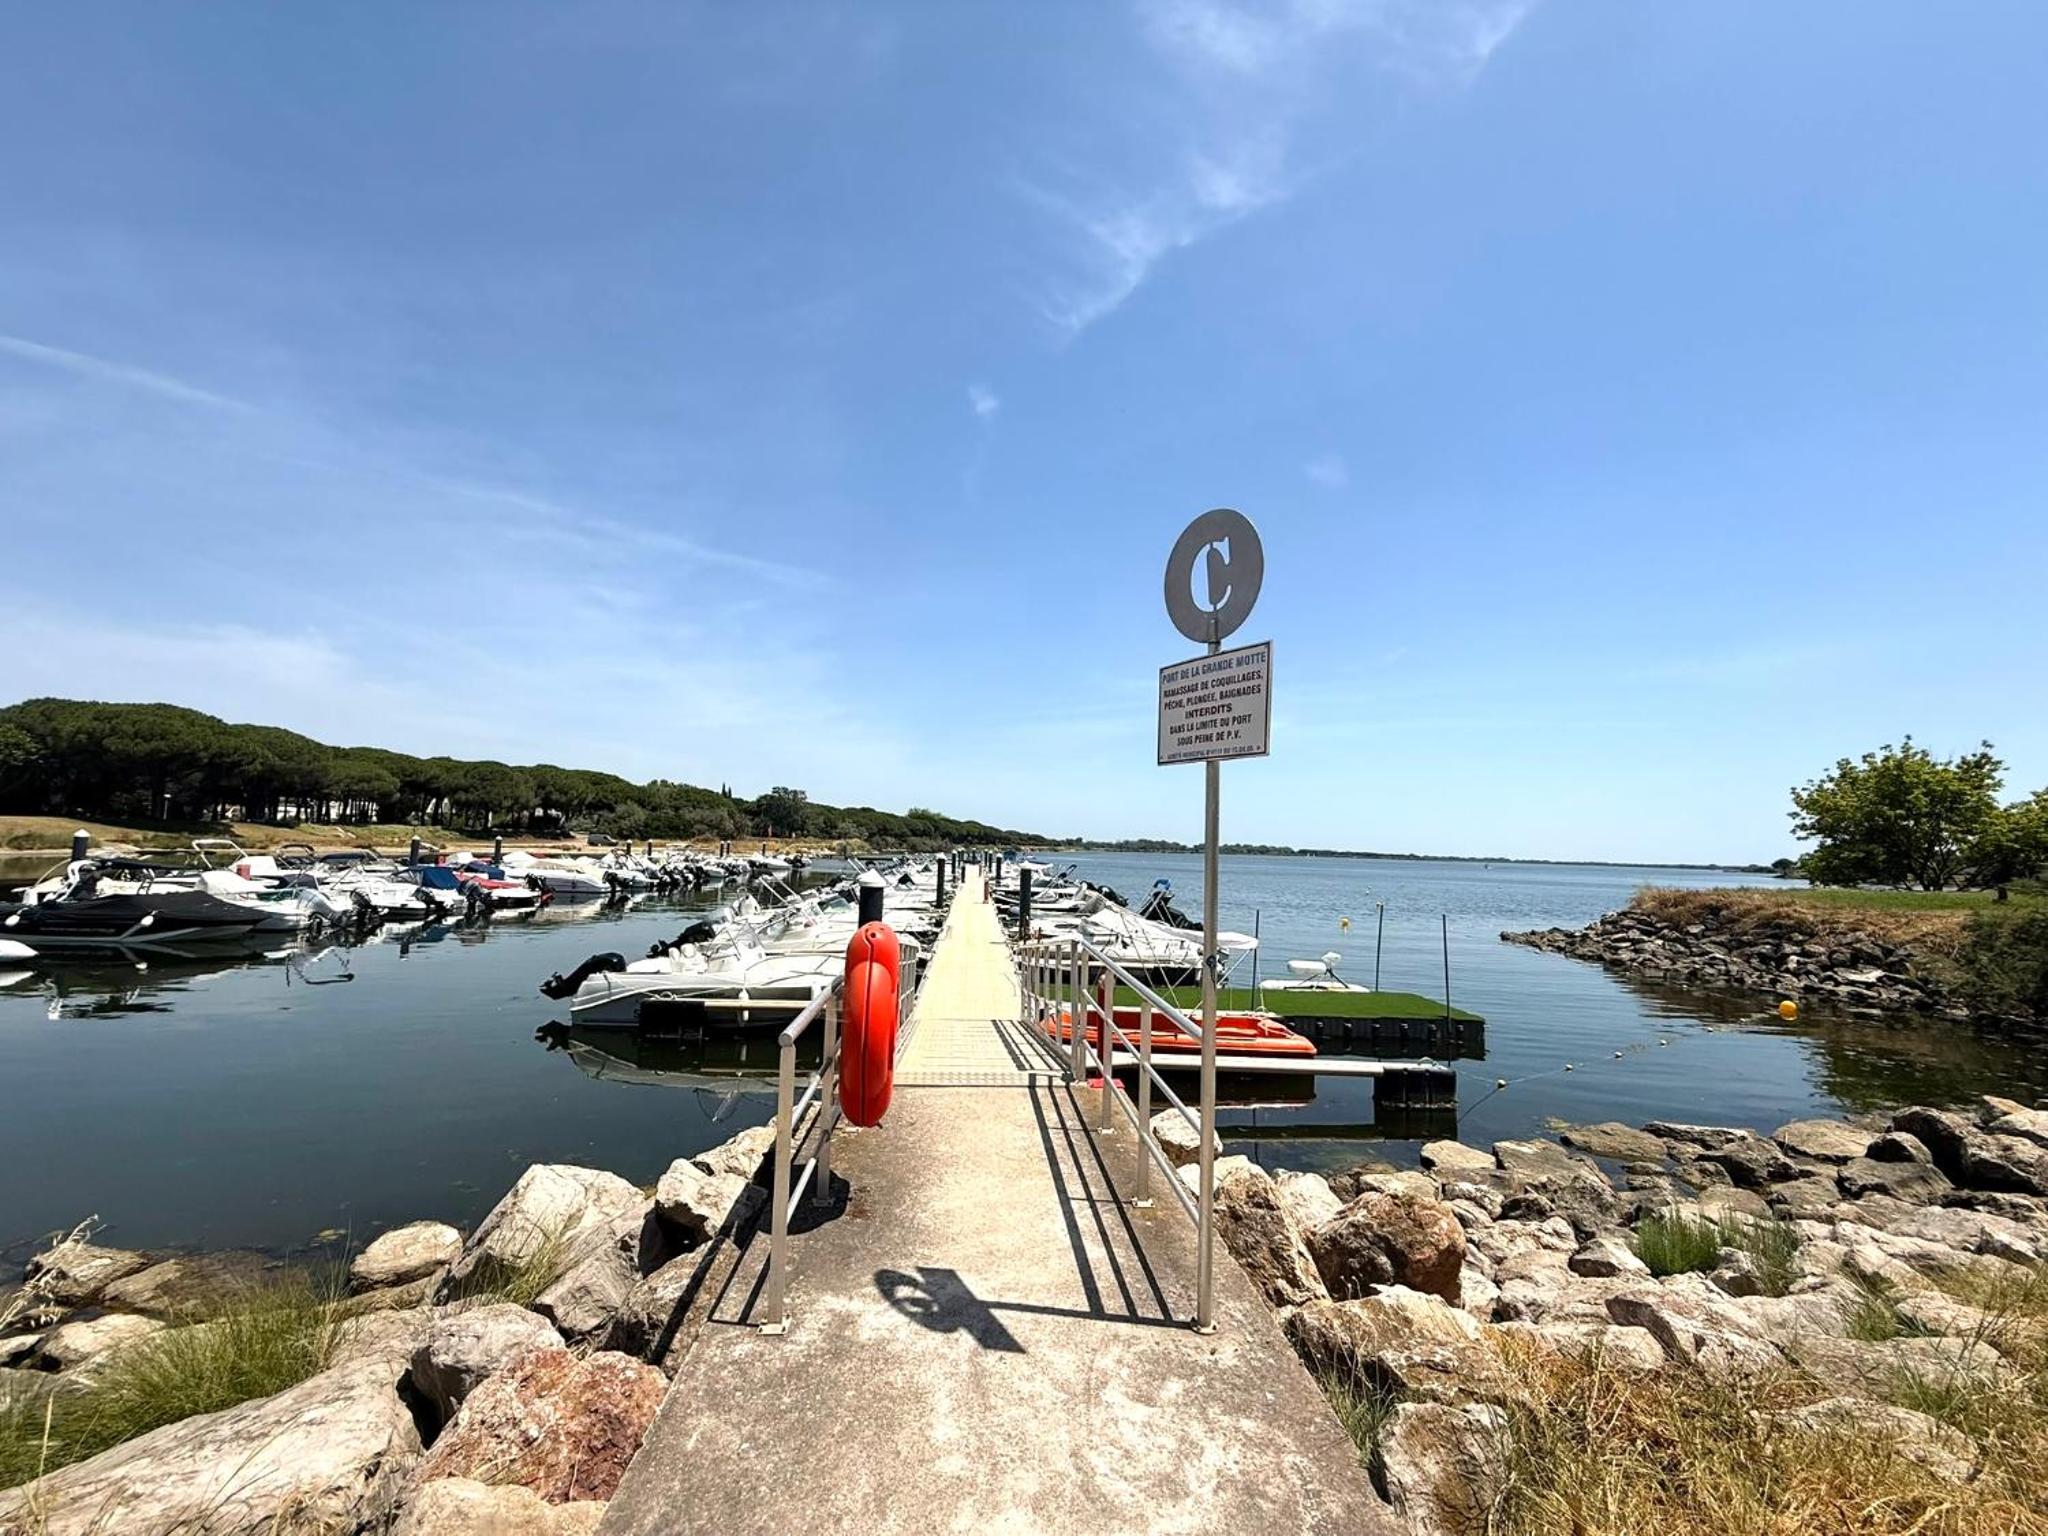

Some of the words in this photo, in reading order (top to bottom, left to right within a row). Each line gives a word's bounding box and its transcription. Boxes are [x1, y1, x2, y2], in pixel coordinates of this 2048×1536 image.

[1190, 536, 1231, 612] C
[1162, 671, 1179, 684] PORT
[1180, 668, 1189, 679] DE
[1191, 666, 1200, 677] LA
[1202, 658, 1233, 674] GRANDE
[1236, 652, 1266, 666] MOTTE
[1163, 682, 1199, 697] RAMASSAGE
[1200, 681, 1209, 690] DE
[1219, 684, 1261, 700] BAIGNADES
[1185, 703, 1232, 719] INTERDITS
[1170, 723, 1185, 735] DANS
[1186, 723, 1194, 732] LA
[1195, 719, 1218, 730] LIMITE
[1220, 717, 1229, 727] DU
[1232, 713, 1252, 725] PORT
[1177, 735, 1193, 747] SOUS
[1194, 733, 1214, 743] PEINE
[1215, 731, 1225, 741] DE
